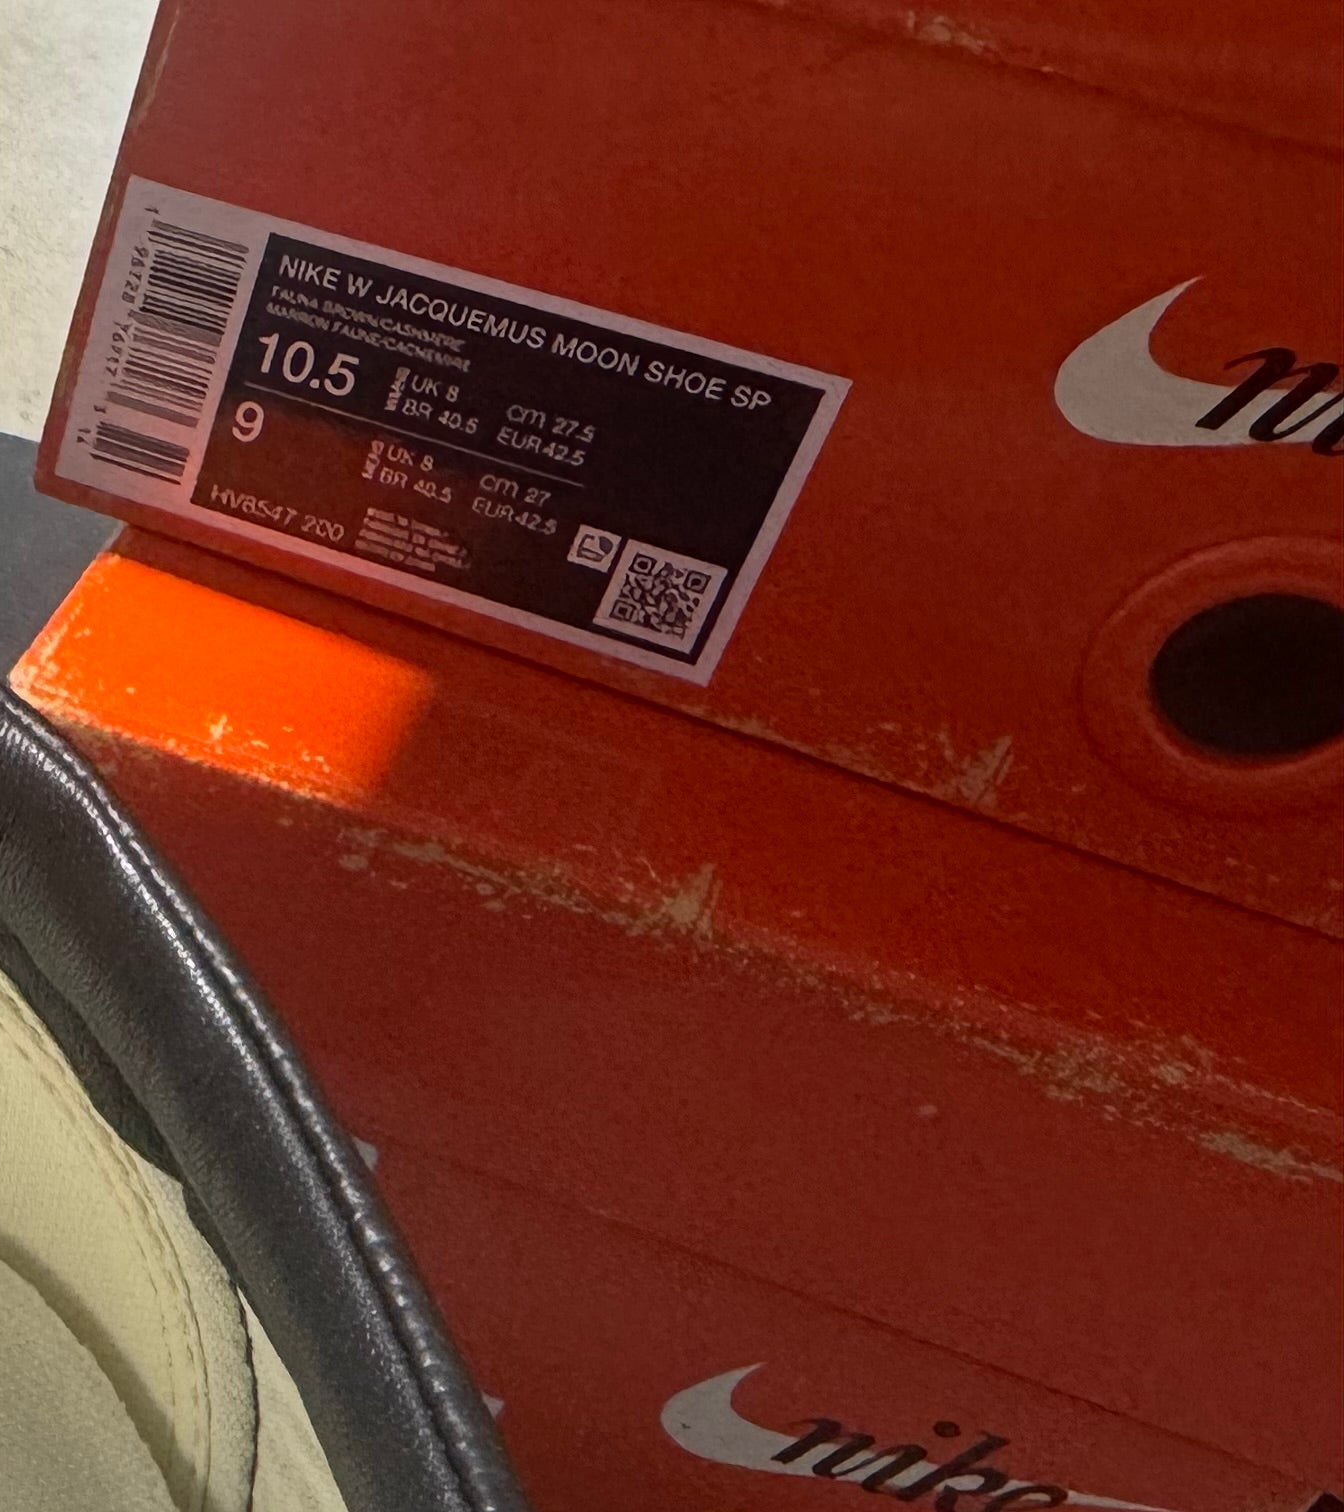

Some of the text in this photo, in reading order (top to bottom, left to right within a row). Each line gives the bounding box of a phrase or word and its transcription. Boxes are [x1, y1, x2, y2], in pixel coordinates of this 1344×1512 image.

[279, 255, 772, 410] NIKE W JACQUEMUS MOON SHOE SP
[259, 333, 360, 396] 10.5
[412, 374, 441, 397] UK
[446, 385, 460, 402] 8
[231, 400, 264, 443] 9
[552, 418, 597, 443] 27.5
[387, 445, 414, 467] UK
[420, 455, 434, 472] 8
[496, 426, 587, 467] EUR 42.5
[210, 484, 298, 527] HV8547
[300, 514, 345, 543] 200
[472, 496, 558, 536] EUR 42.5
[524, 487, 552, 508] 27
